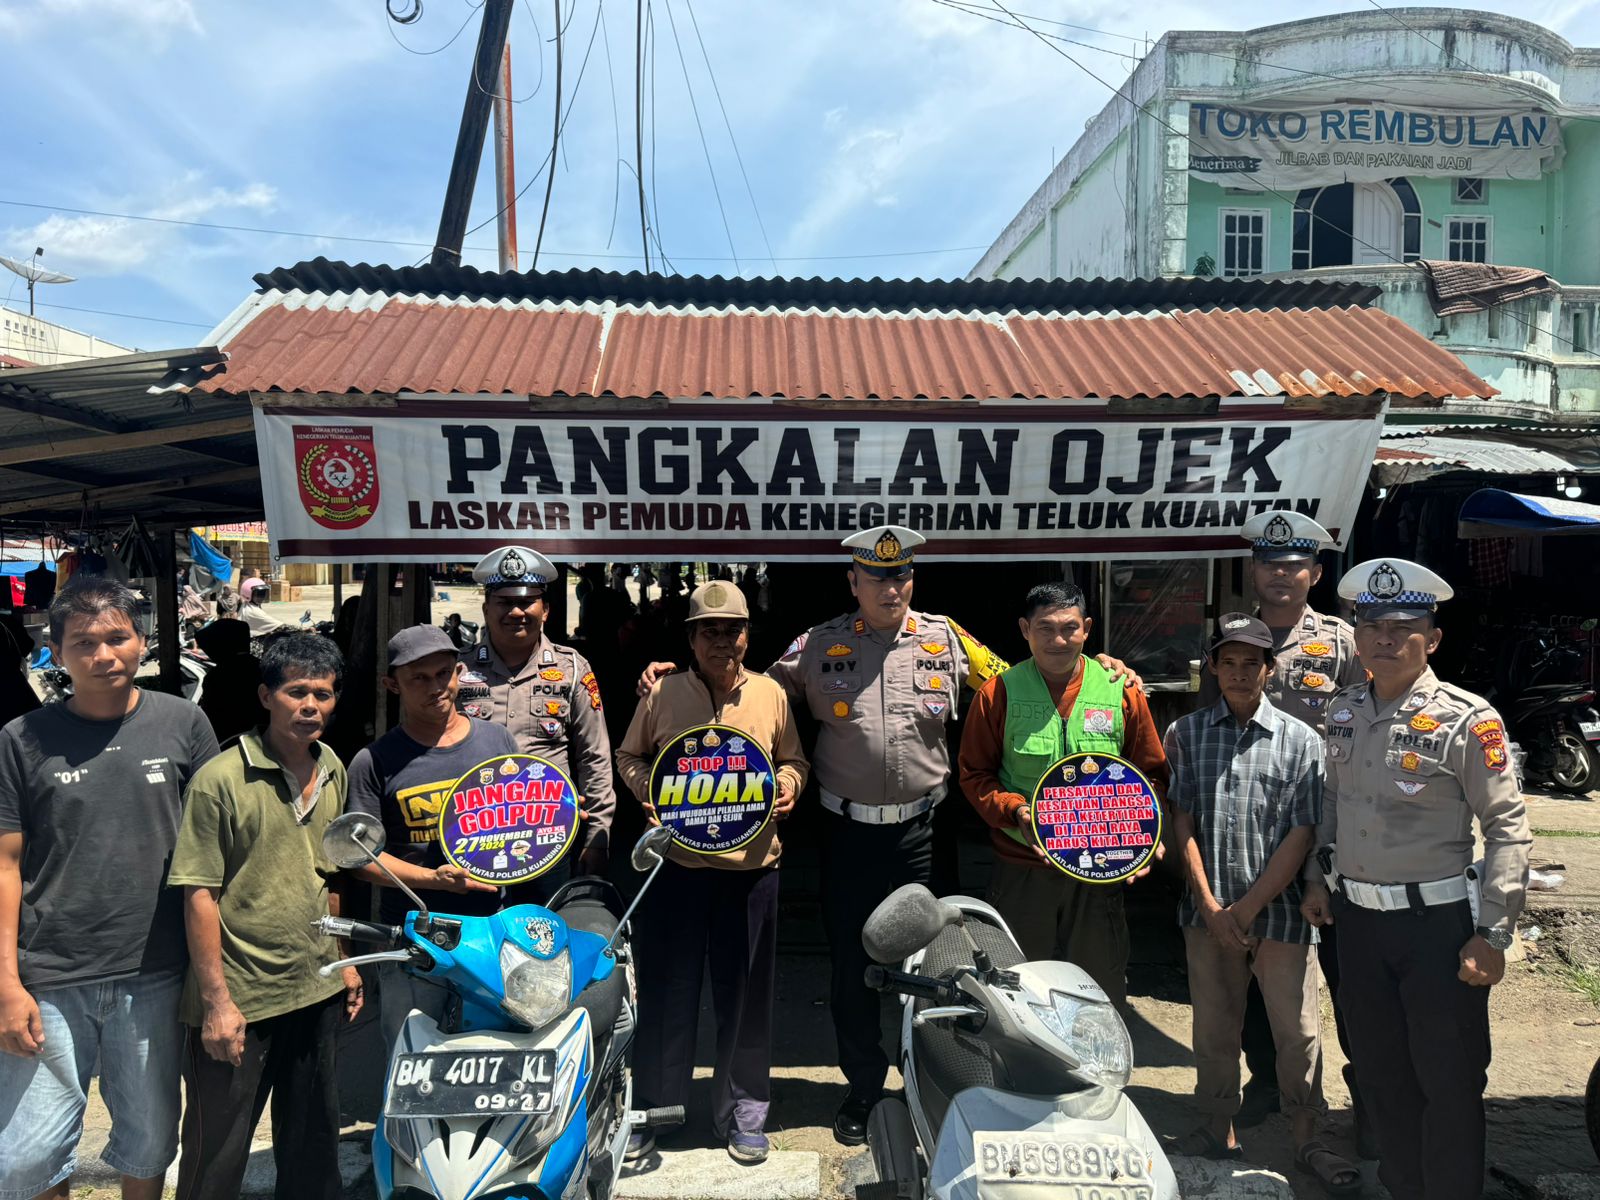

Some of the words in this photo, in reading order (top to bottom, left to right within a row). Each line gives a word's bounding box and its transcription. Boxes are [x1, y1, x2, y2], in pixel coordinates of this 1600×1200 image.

[1191, 104, 1307, 140] TOKO
[1320, 109, 1547, 147] REMBULAN
[1276, 151, 1331, 166] JILBAB
[1334, 152, 1364, 166] DAN
[1367, 154, 1433, 168] PAKAIAN
[1437, 156, 1472, 171] JADI
[441, 424, 1019, 496] PANGKALAN
[1049, 427, 1292, 496] OJEK
[408, 500, 571, 530] LASKAR
[583, 502, 751, 531] PEMUDA
[761, 502, 1002, 531] KENEGERIAN
[1013, 502, 1131, 529] TELUK
[917, 659, 950, 671] POLRI
[1293, 659, 1333, 672] POLRI
[533, 685, 571, 696] POLRI
[1394, 732, 1440, 751] POLRI
[677, 756, 724, 772] STOP
[727, 755, 747, 771] !!!
[453, 780, 565, 814] JANGAN
[658, 772, 768, 806] HOAX
[1043, 784, 1115, 799] PERSATUAN
[1116, 783, 1142, 795] DAN
[661, 810, 678, 821] MARI
[717, 804, 745, 815] PILKADA
[746, 802, 765, 812] AMAN
[1036, 797, 1100, 812] KESATUAN
[1102, 795, 1153, 809] BANGSA
[458, 803, 562, 836] GOLPUT
[685, 816, 707, 826] DAMAI
[708, 815, 722, 824] DAN
[722, 812, 743, 822] SEJUK
[1038, 811, 1077, 825] SERTA
[1079, 808, 1154, 822] KETERTIBAN
[537, 832, 566, 845] TPS
[665, 823, 701, 848] SATLANTAS
[702, 840, 731, 850] POLRES
[731, 820, 762, 845] KUANSING
[1054, 825, 1069, 837] DI
[1070, 823, 1108, 836] JALAN
[1109, 821, 1142, 834] RAYA
[453, 836, 480, 854] 27
[478, 829, 533, 844] NOVEMBER
[478, 840, 506, 851] 2024
[1045, 837, 1088, 850] HARUS
[1090, 835, 1121, 848] KITA
[1121, 833, 1154, 847] JAGA
[456, 855, 495, 878] SATLANTAS
[496, 869, 528, 879] POLRES
[529, 844, 562, 871] KUANSING
[1052, 852, 1089, 877] SATLANTAS
[1090, 869, 1120, 879] POLRES
[1120, 848, 1149, 874] KUANSING
[515, 916, 559, 928] HONDA
[396, 1057, 434, 1086] BM
[444, 1056, 504, 1085] 4017
[521, 1055, 552, 1083] KL
